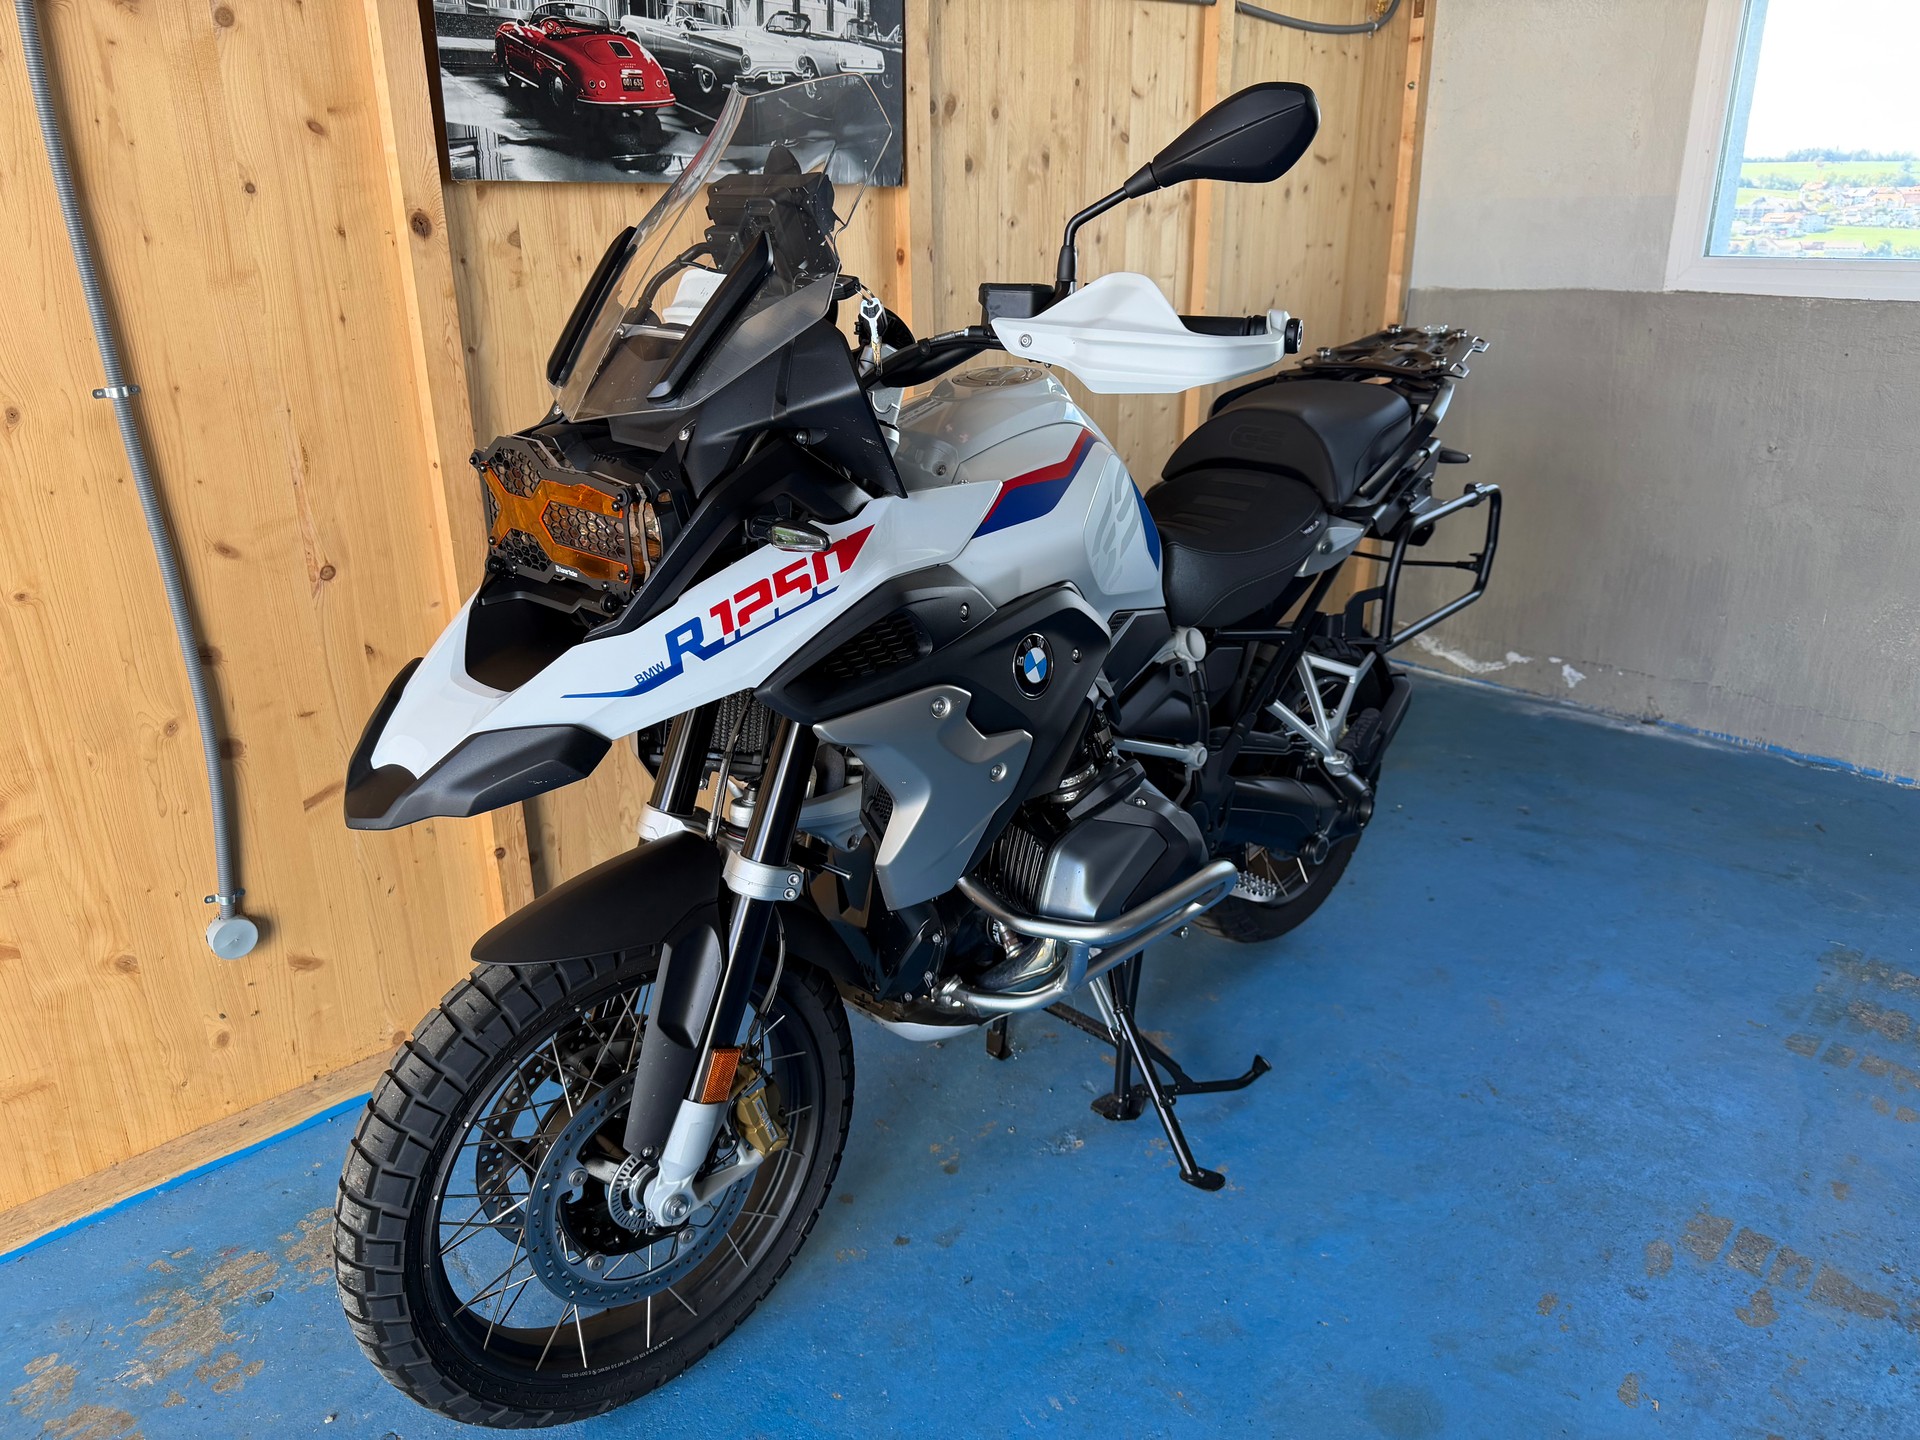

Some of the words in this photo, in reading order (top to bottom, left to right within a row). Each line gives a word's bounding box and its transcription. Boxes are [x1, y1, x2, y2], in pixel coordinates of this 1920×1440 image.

[634, 660, 666, 685] BMW
[665, 616, 706, 664] R
[1016, 636, 1045, 667] BMW
